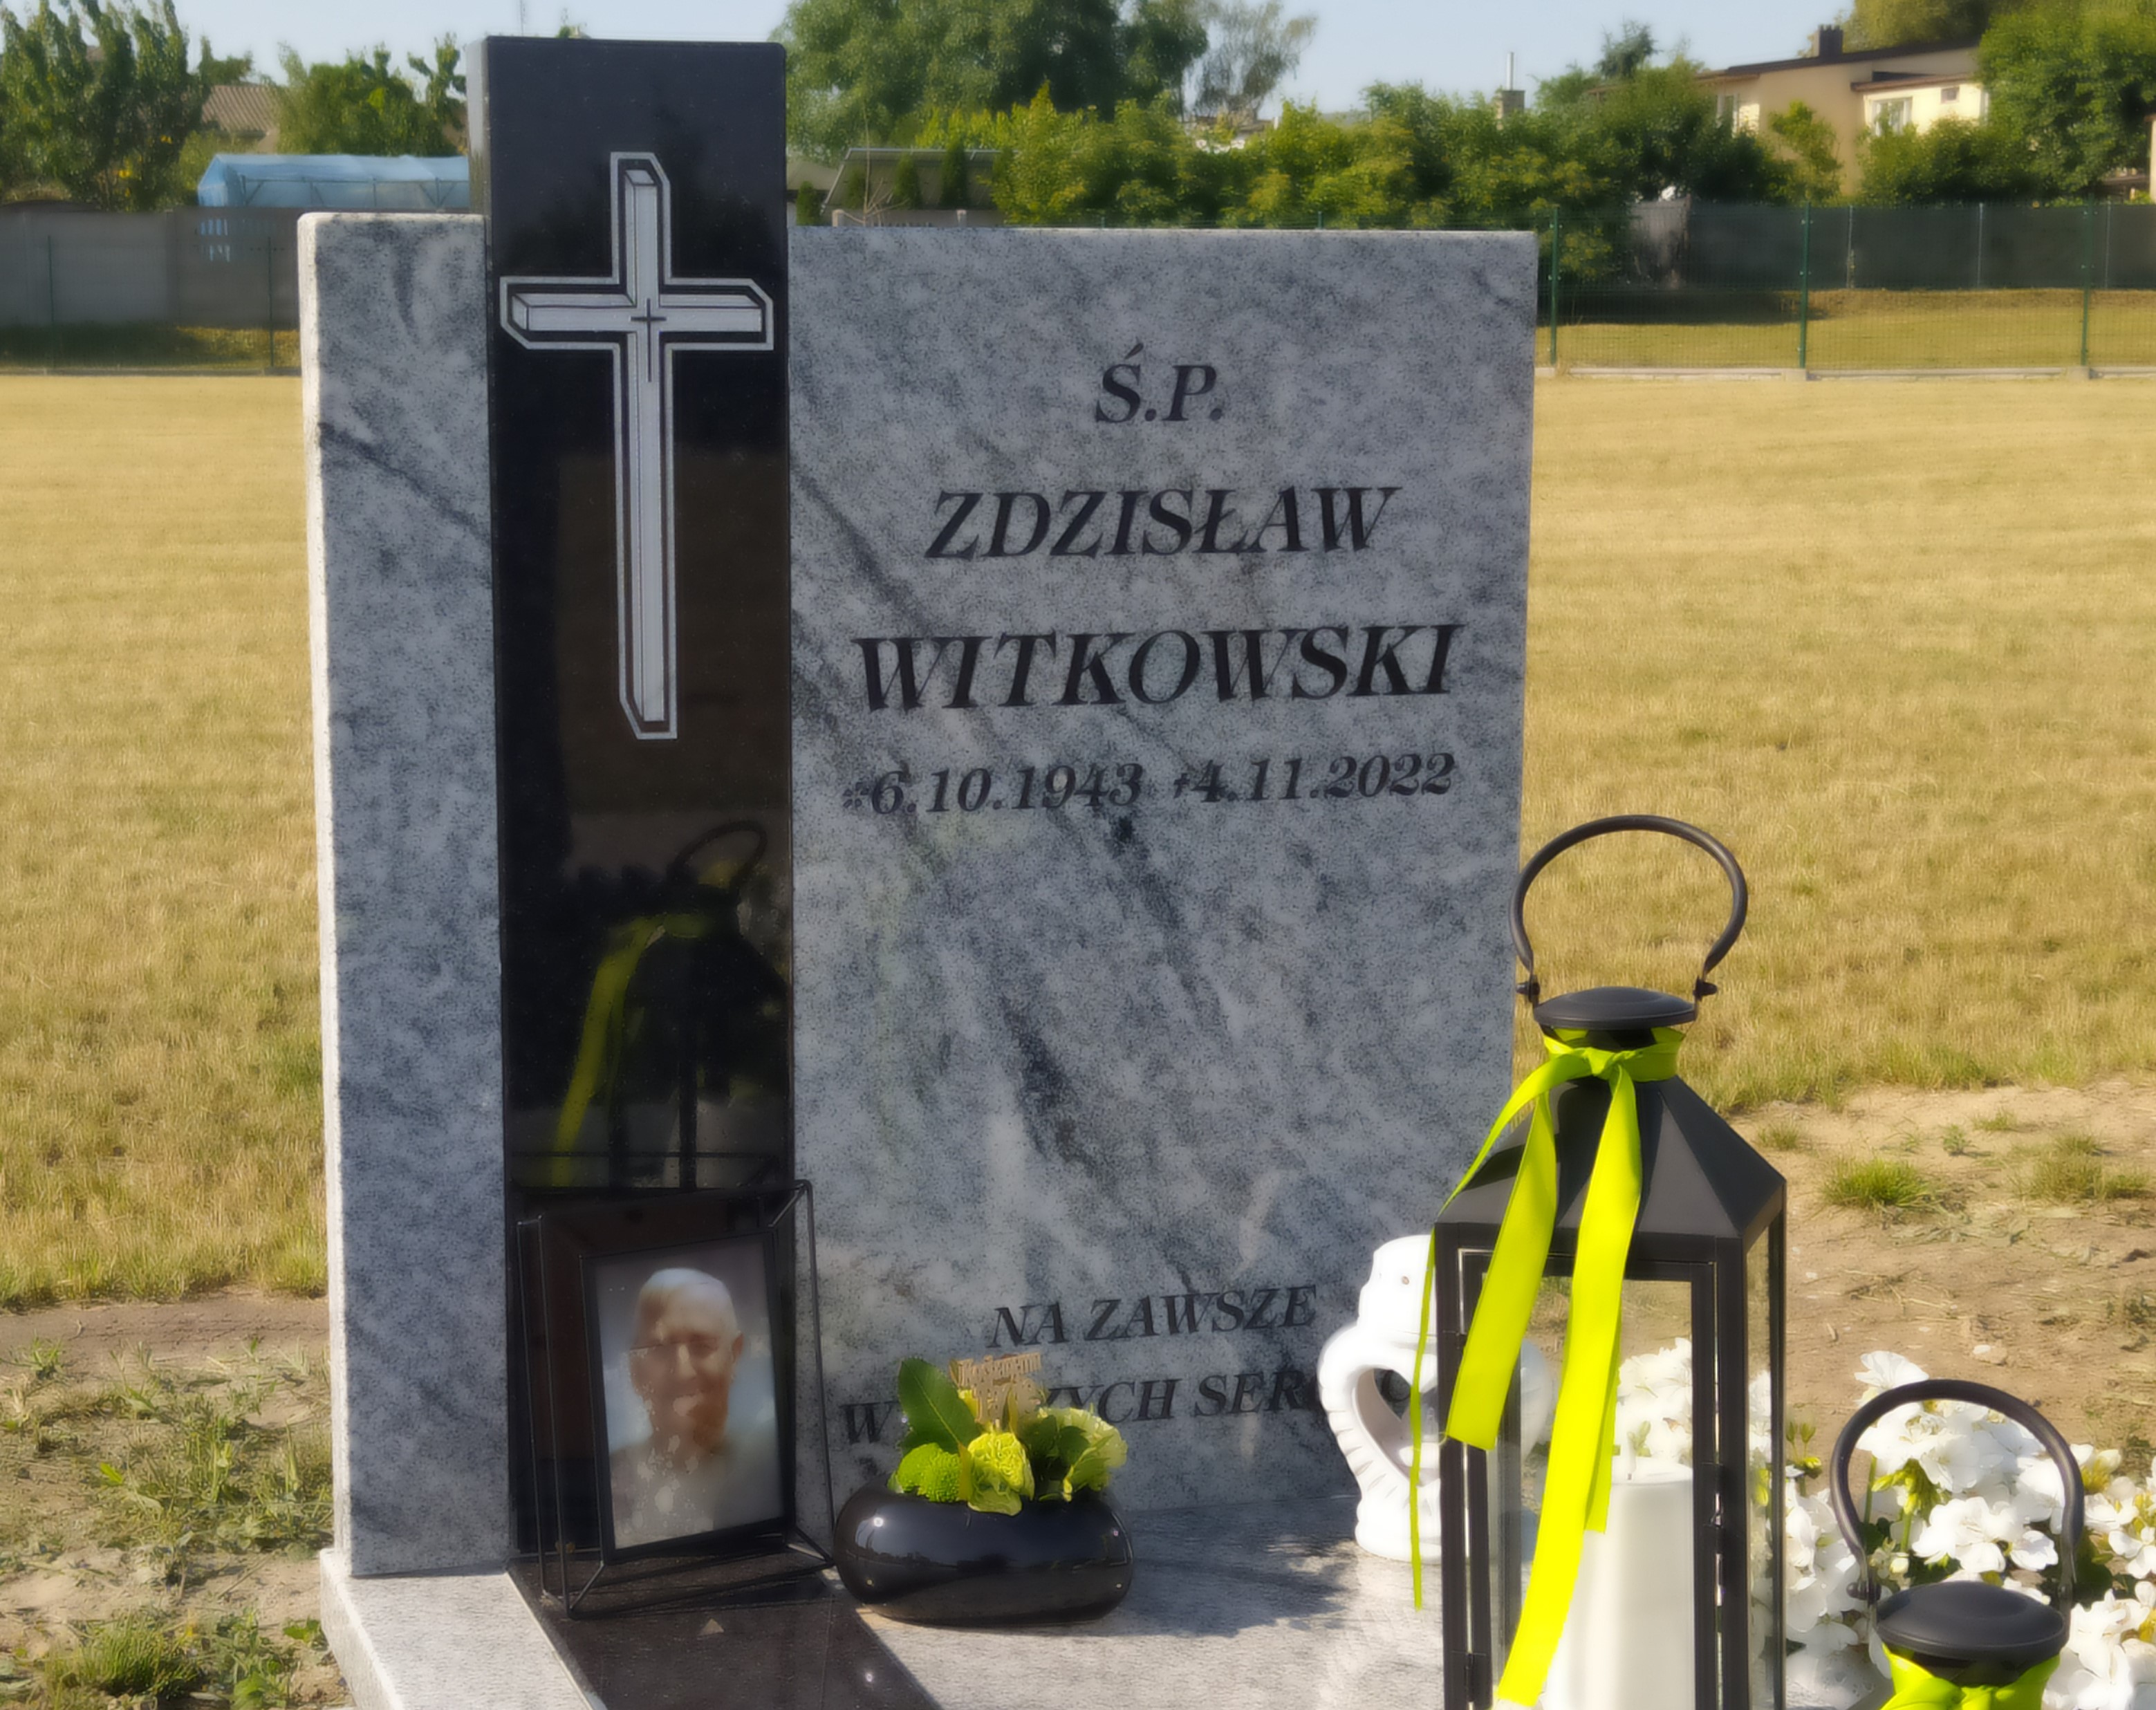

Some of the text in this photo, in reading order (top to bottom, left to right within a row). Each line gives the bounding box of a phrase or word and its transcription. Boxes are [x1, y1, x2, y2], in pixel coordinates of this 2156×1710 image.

[1095, 342, 1224, 423] Ś.P.
[924, 485, 1403, 559] ZDZISŁAW
[851, 624, 1467, 714] WITKOWSKI
[986, 1284, 1317, 1348] NA ZAWSZE
[839, 1400, 900, 1444] W
